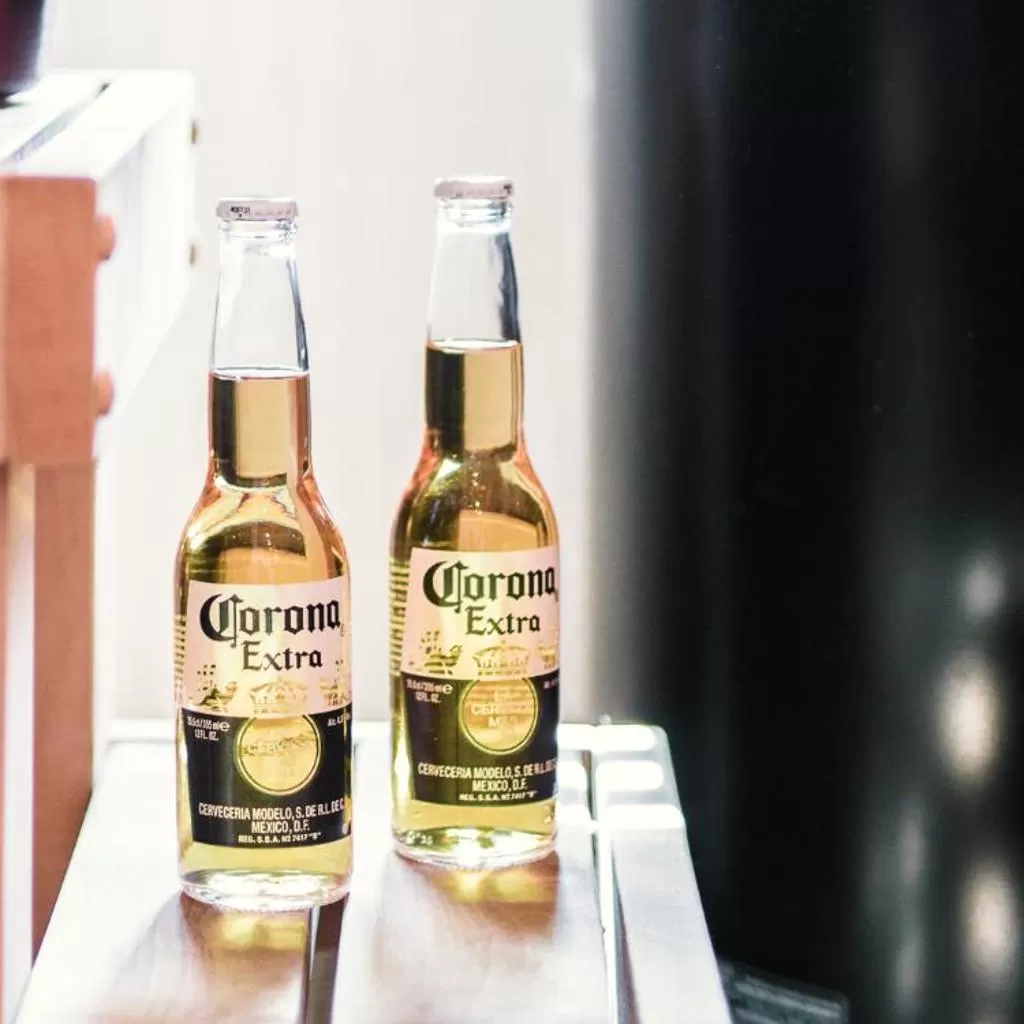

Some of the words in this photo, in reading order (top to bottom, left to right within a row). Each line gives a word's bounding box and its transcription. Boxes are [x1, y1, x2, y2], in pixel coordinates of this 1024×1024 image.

[422, 560, 558, 614] Corona
[199, 593, 344, 649] Corona
[465, 606, 540, 636] Extra
[241, 640, 323, 671] Extra
[417, 762, 472, 779] CERVECERIA
[473, 766, 513, 780] MODELO,
[471, 779, 512, 793] MEXICO,
[198, 802, 251, 820] CERVECERIA
[252, 807, 295, 821] MODELO,
[295, 806, 305, 818] S.
[305, 804, 317, 818] DE
[331, 799, 340, 813] DE
[251, 820, 293, 834] MEXICO,
[293, 819, 310, 833] D.F.
